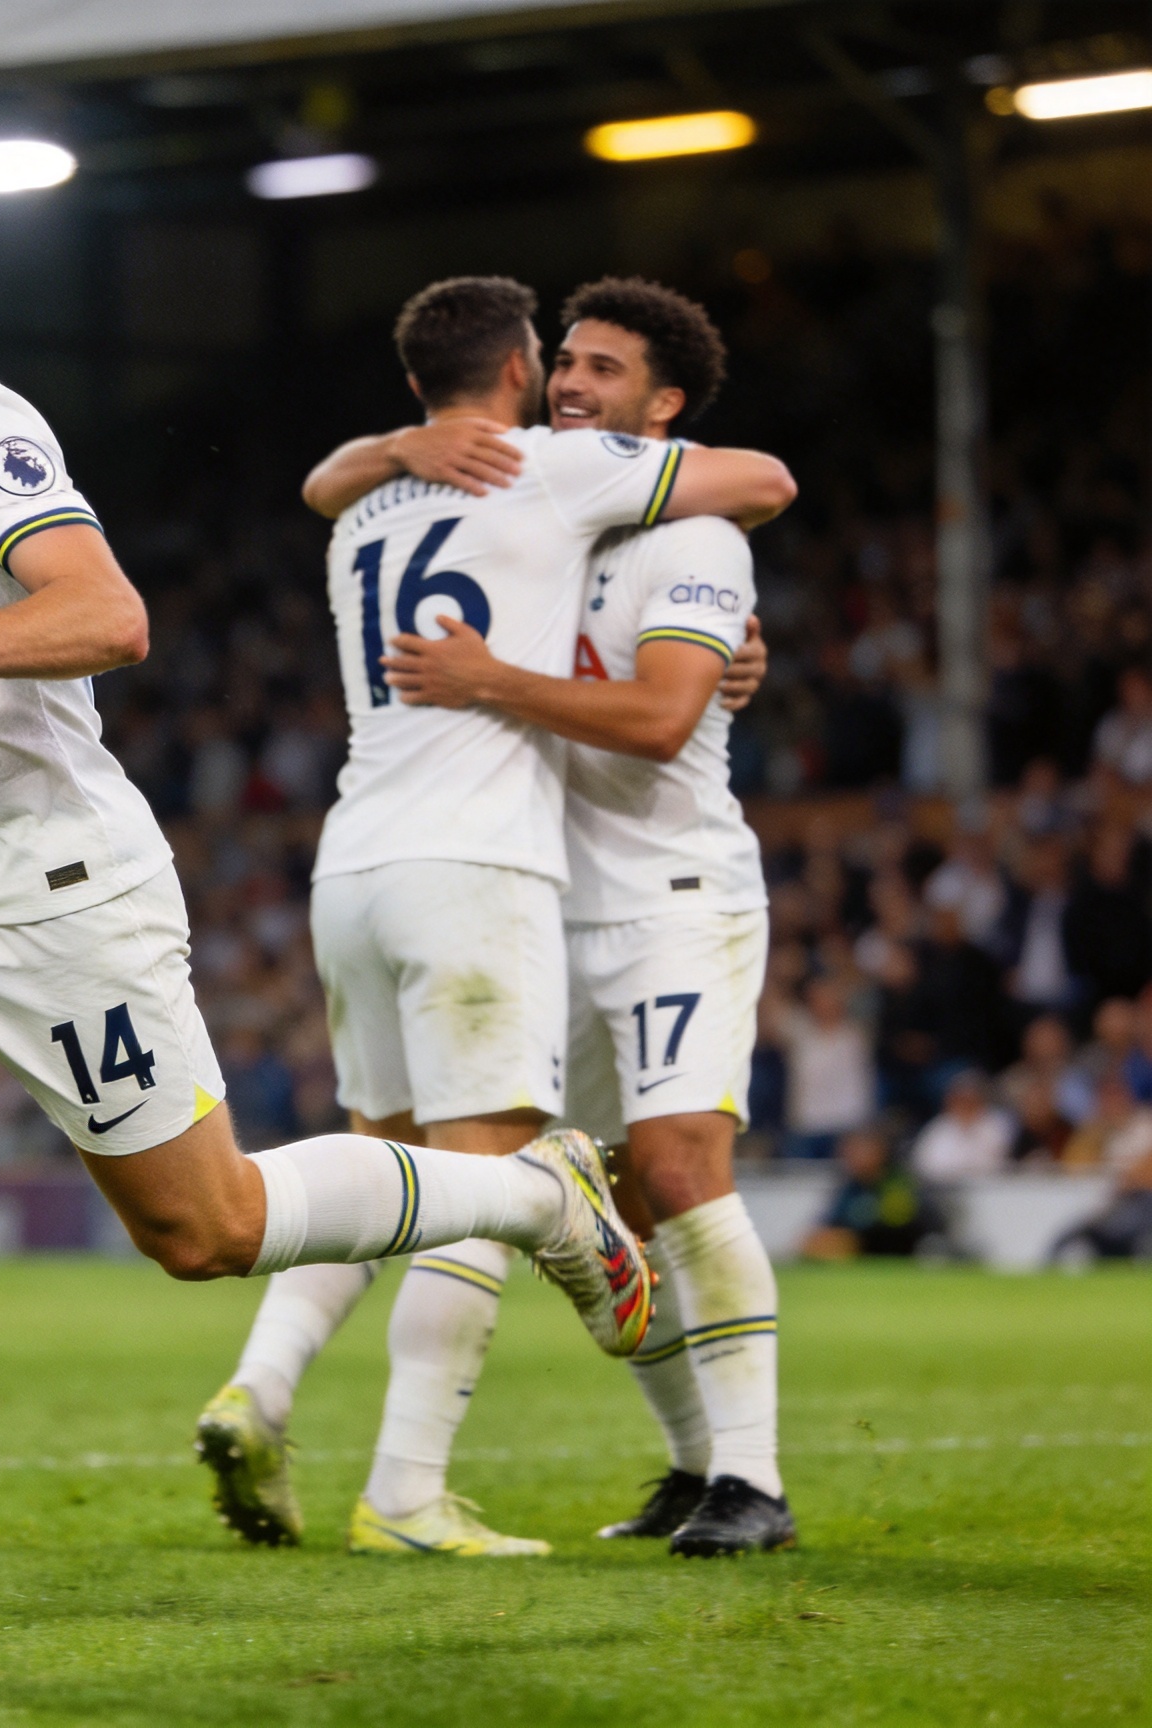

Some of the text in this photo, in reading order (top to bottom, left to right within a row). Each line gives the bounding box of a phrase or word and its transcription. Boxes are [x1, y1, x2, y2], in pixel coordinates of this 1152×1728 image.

[352, 516, 491, 708] 16
[50, 1002, 156, 1104] 14
[631, 991, 702, 1070] 17
